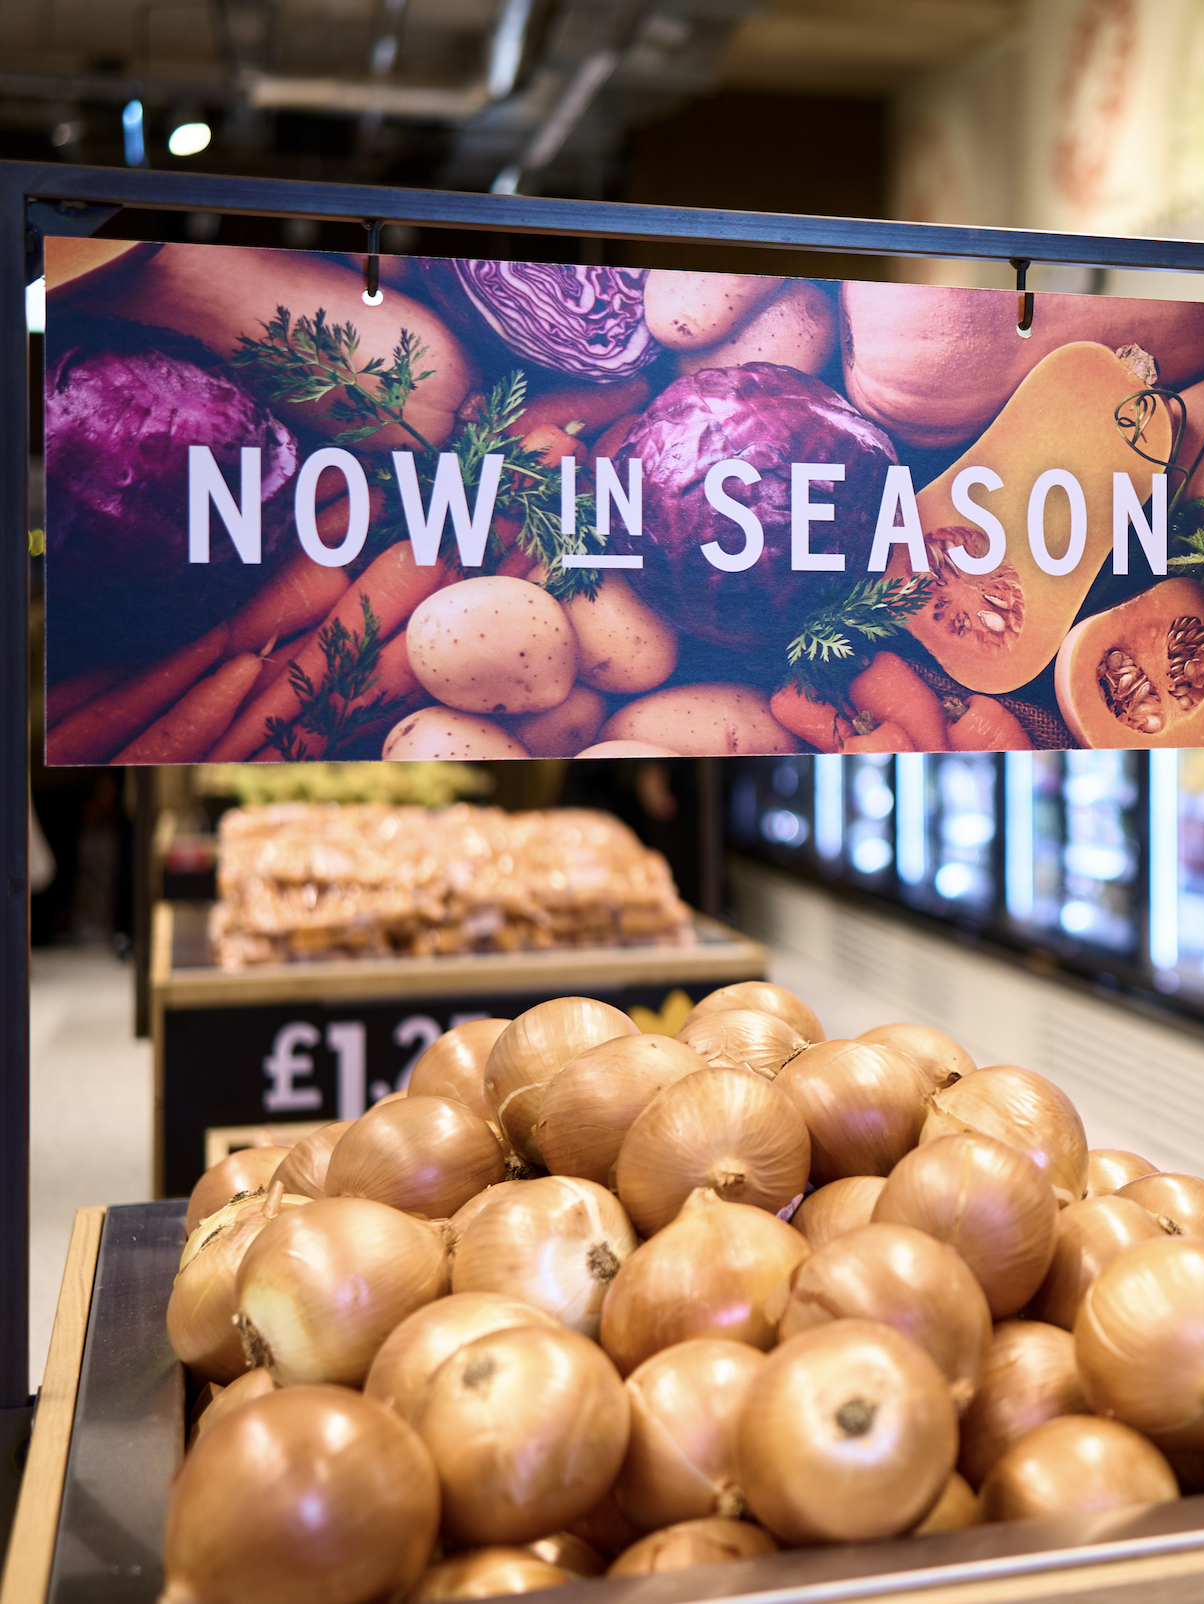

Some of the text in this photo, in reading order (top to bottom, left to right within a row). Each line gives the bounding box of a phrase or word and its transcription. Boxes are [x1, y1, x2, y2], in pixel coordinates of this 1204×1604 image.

[188, 446, 1168, 576] NOW IN SEASON
[262, 1011, 490, 1122] £1.2
